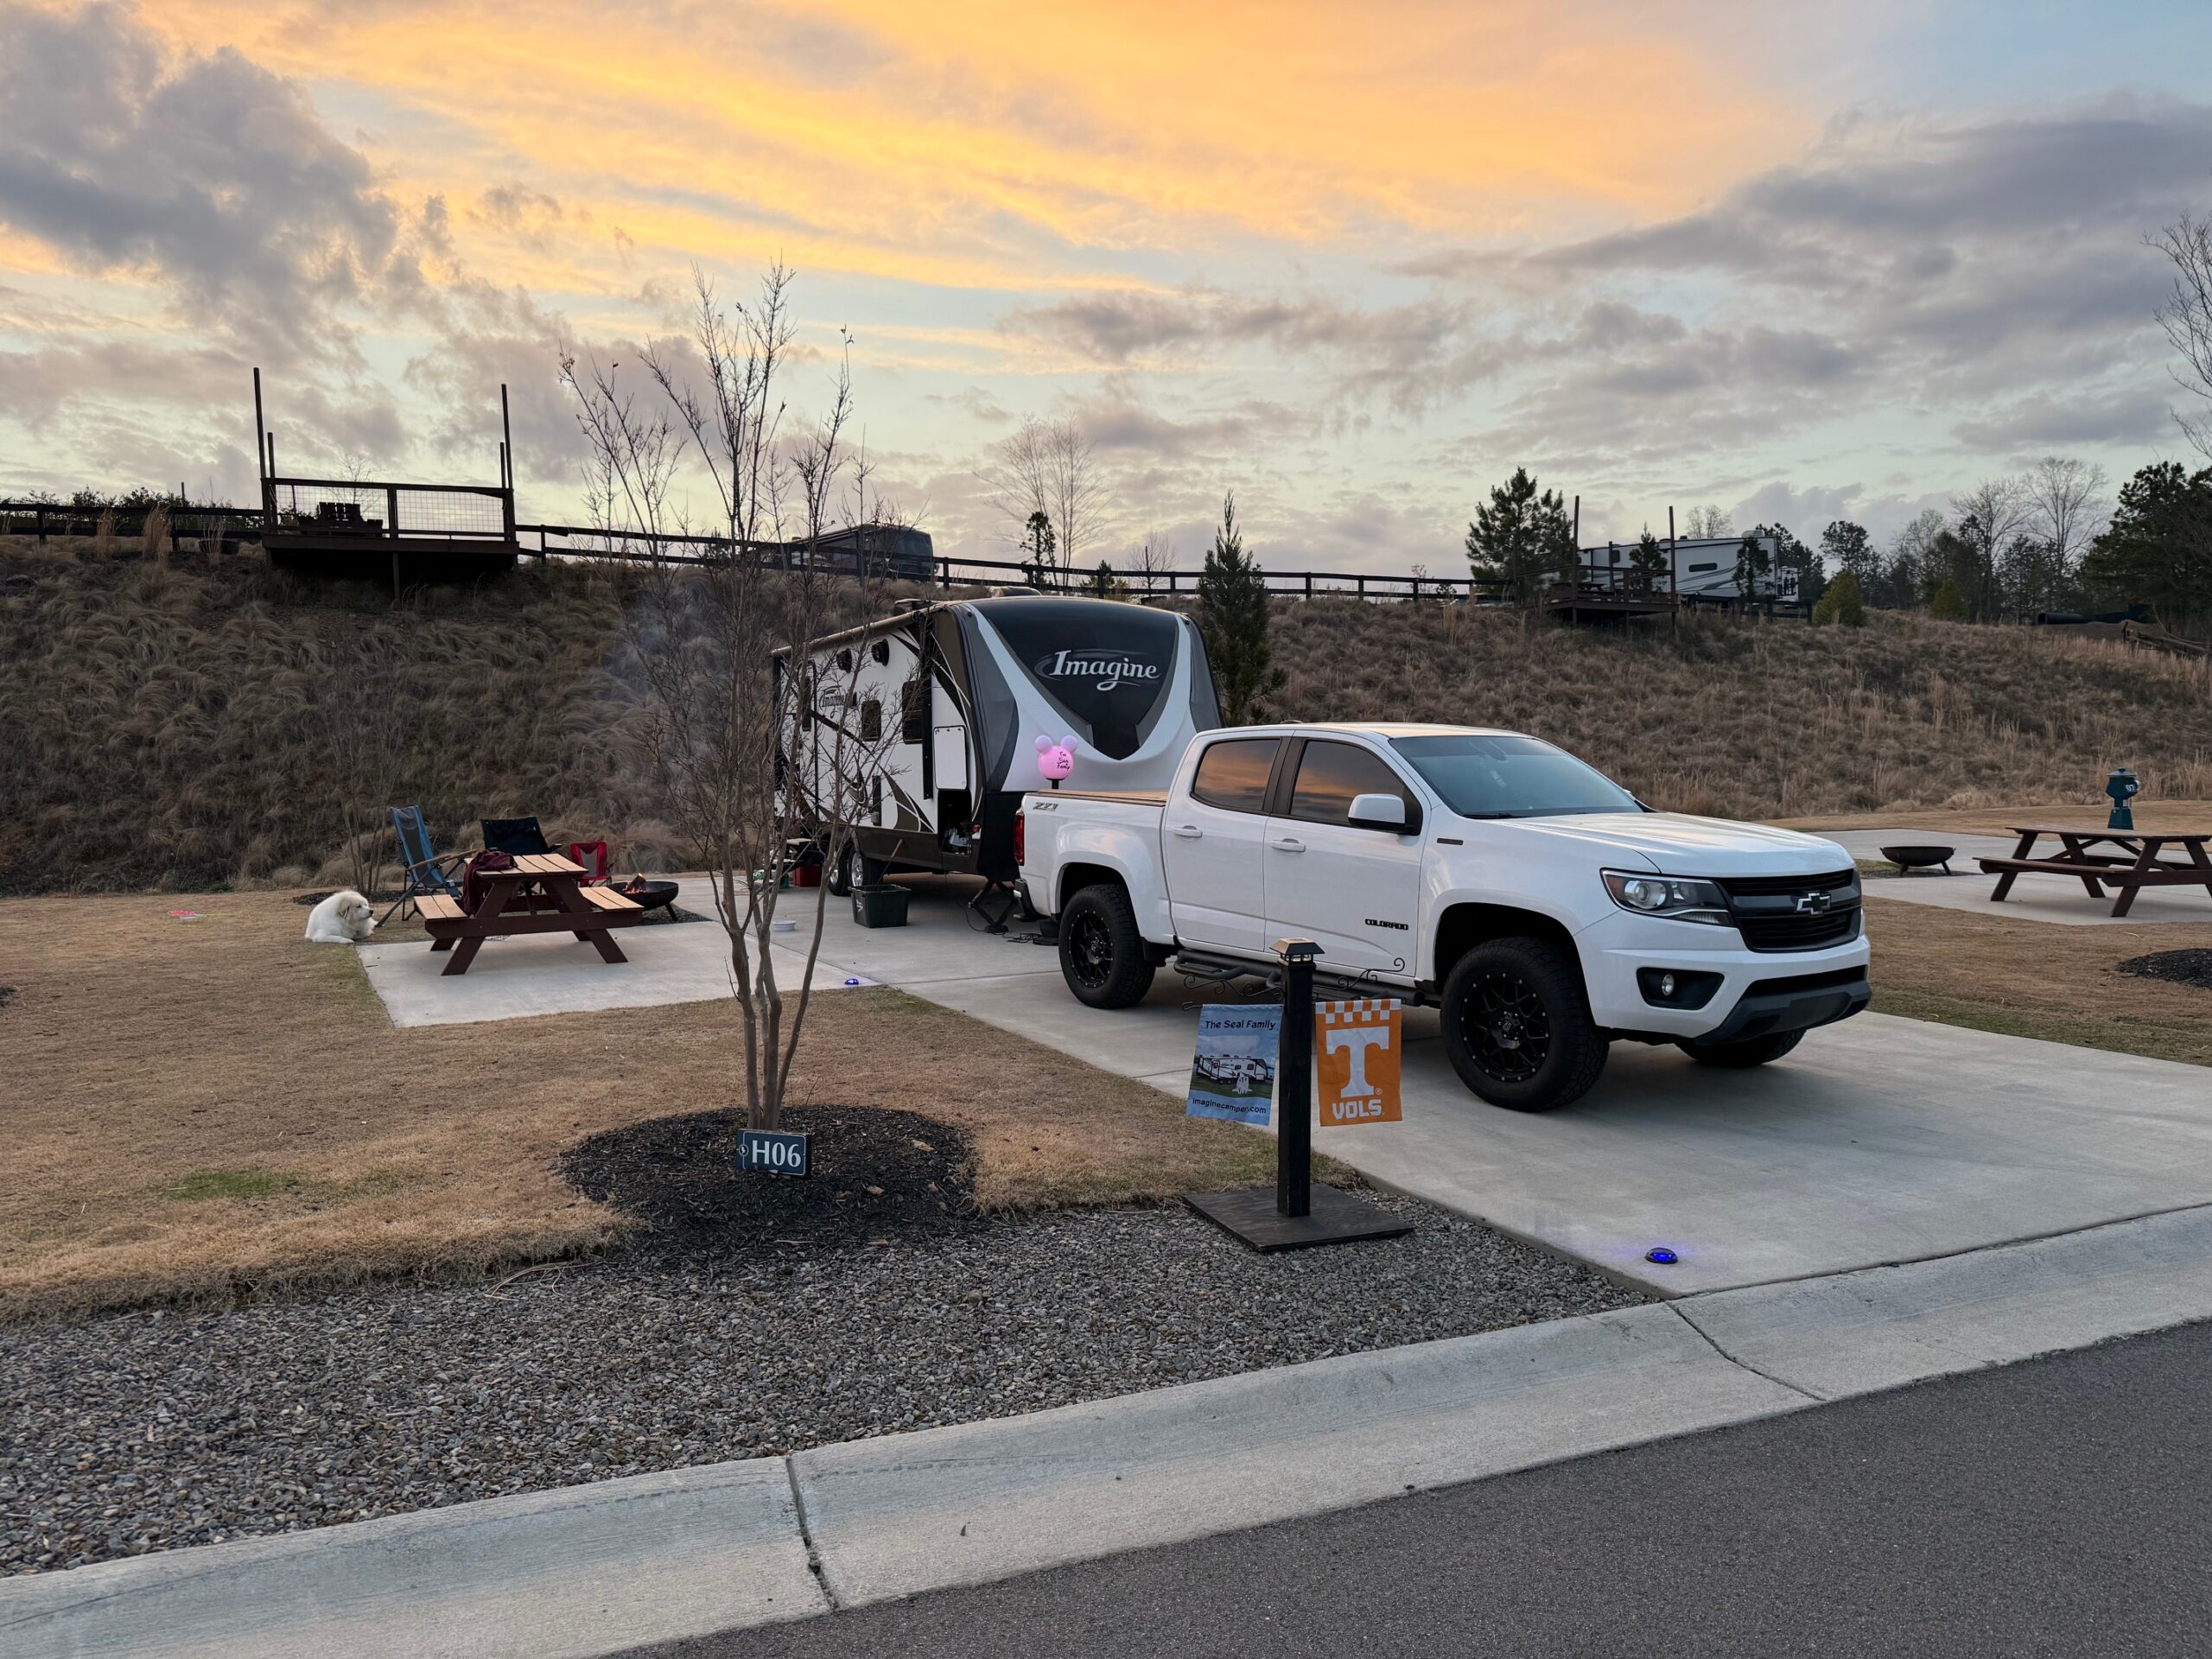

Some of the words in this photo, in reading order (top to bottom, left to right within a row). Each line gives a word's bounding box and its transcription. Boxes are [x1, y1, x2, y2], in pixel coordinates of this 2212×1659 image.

[1049, 650, 1161, 690] Imagine
[1365, 918, 1408, 930] COLORADO
[1205, 1020, 1222, 1030] The
[1224, 1020, 1243, 1029] Seal
[1246, 1020, 1276, 1031] Family
[1332, 1098, 1382, 1120] VOLS
[752, 1140, 801, 1167] H06
